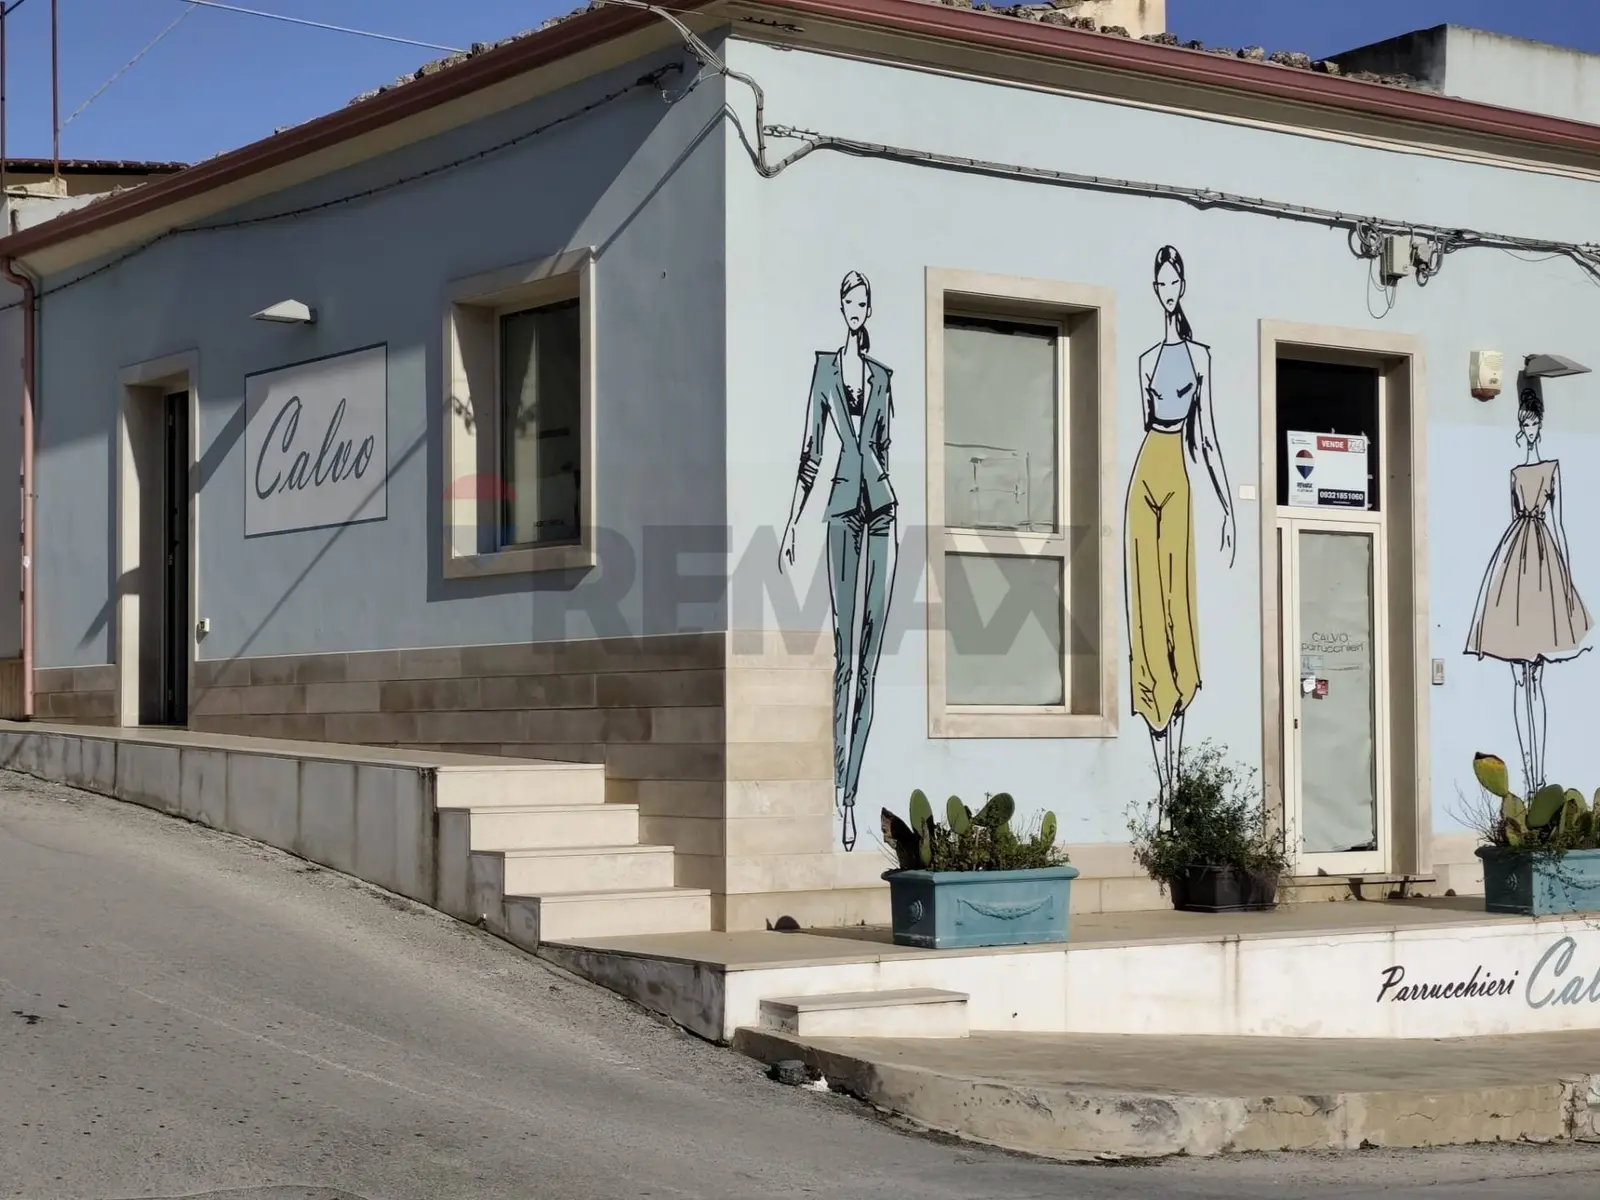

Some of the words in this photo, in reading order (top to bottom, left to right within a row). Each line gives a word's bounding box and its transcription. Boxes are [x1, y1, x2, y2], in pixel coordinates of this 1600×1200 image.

[256, 396, 375, 499] Calvo
[1321, 440, 1344, 449] VENDE
[1312, 631, 1349, 643] CALVO
[1376, 965, 1519, 1003] Parrucchieri
